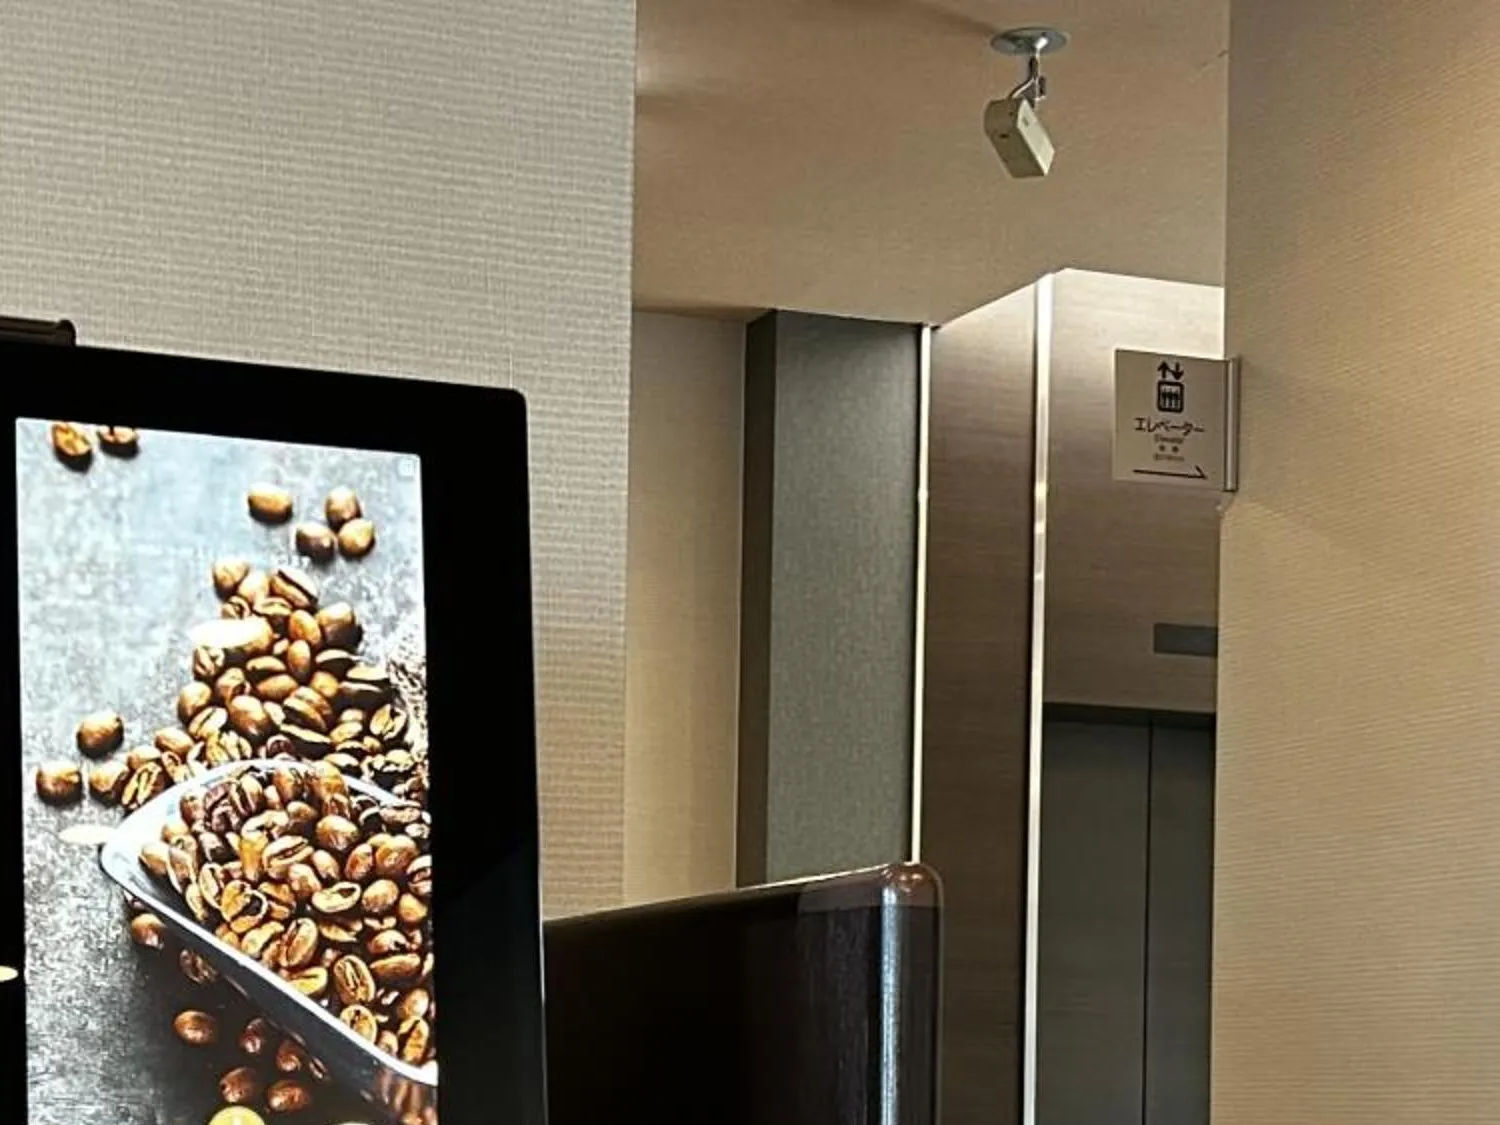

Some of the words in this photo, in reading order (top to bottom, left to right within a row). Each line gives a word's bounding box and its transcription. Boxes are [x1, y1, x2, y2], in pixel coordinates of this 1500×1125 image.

[1133, 416, 1206, 437] エレベーター
